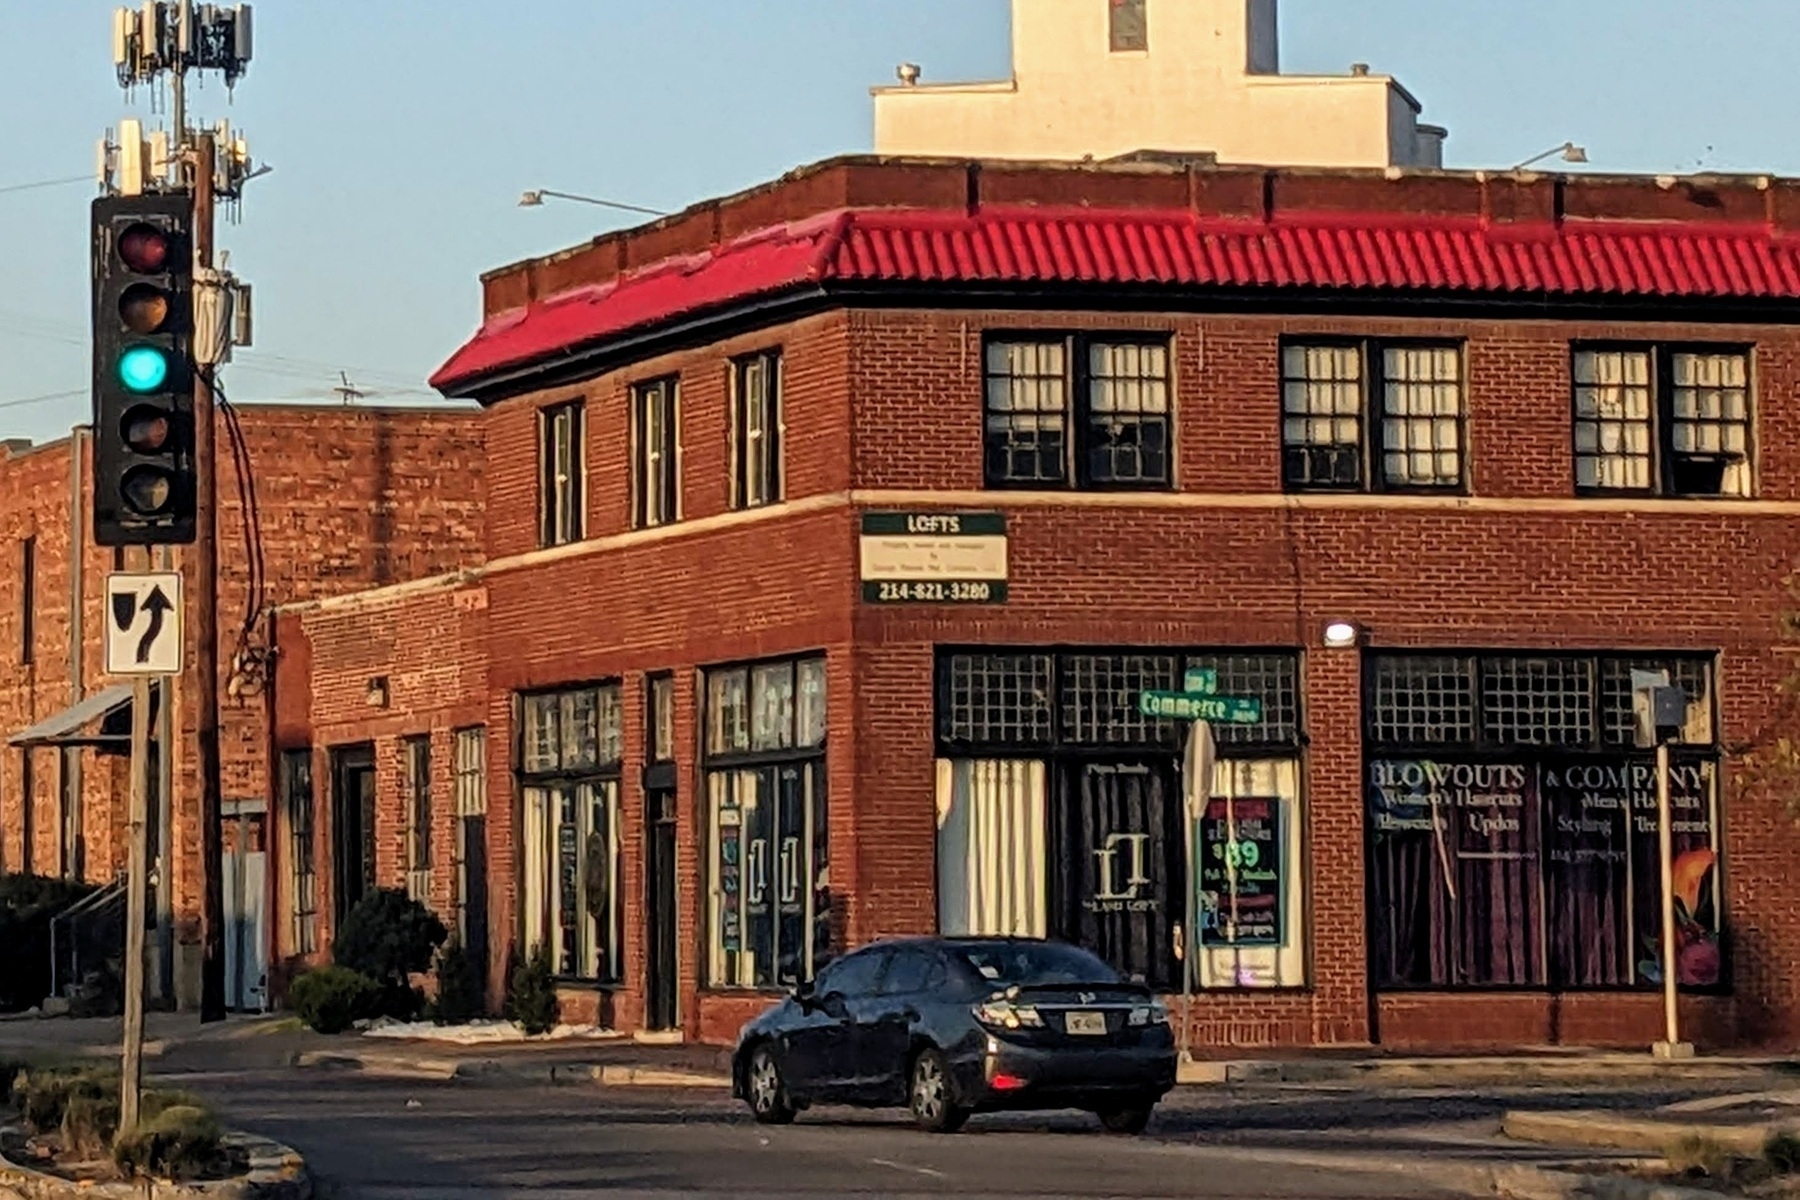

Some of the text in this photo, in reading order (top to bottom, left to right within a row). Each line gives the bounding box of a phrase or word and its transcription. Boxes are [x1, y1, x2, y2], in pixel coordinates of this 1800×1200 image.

[908, 515, 960, 532] LOFTS
[1141, 692, 1226, 719] Commerce
[1371, 760, 1526, 788] BLOWOUTS
[1469, 813, 1520, 836] Updos
